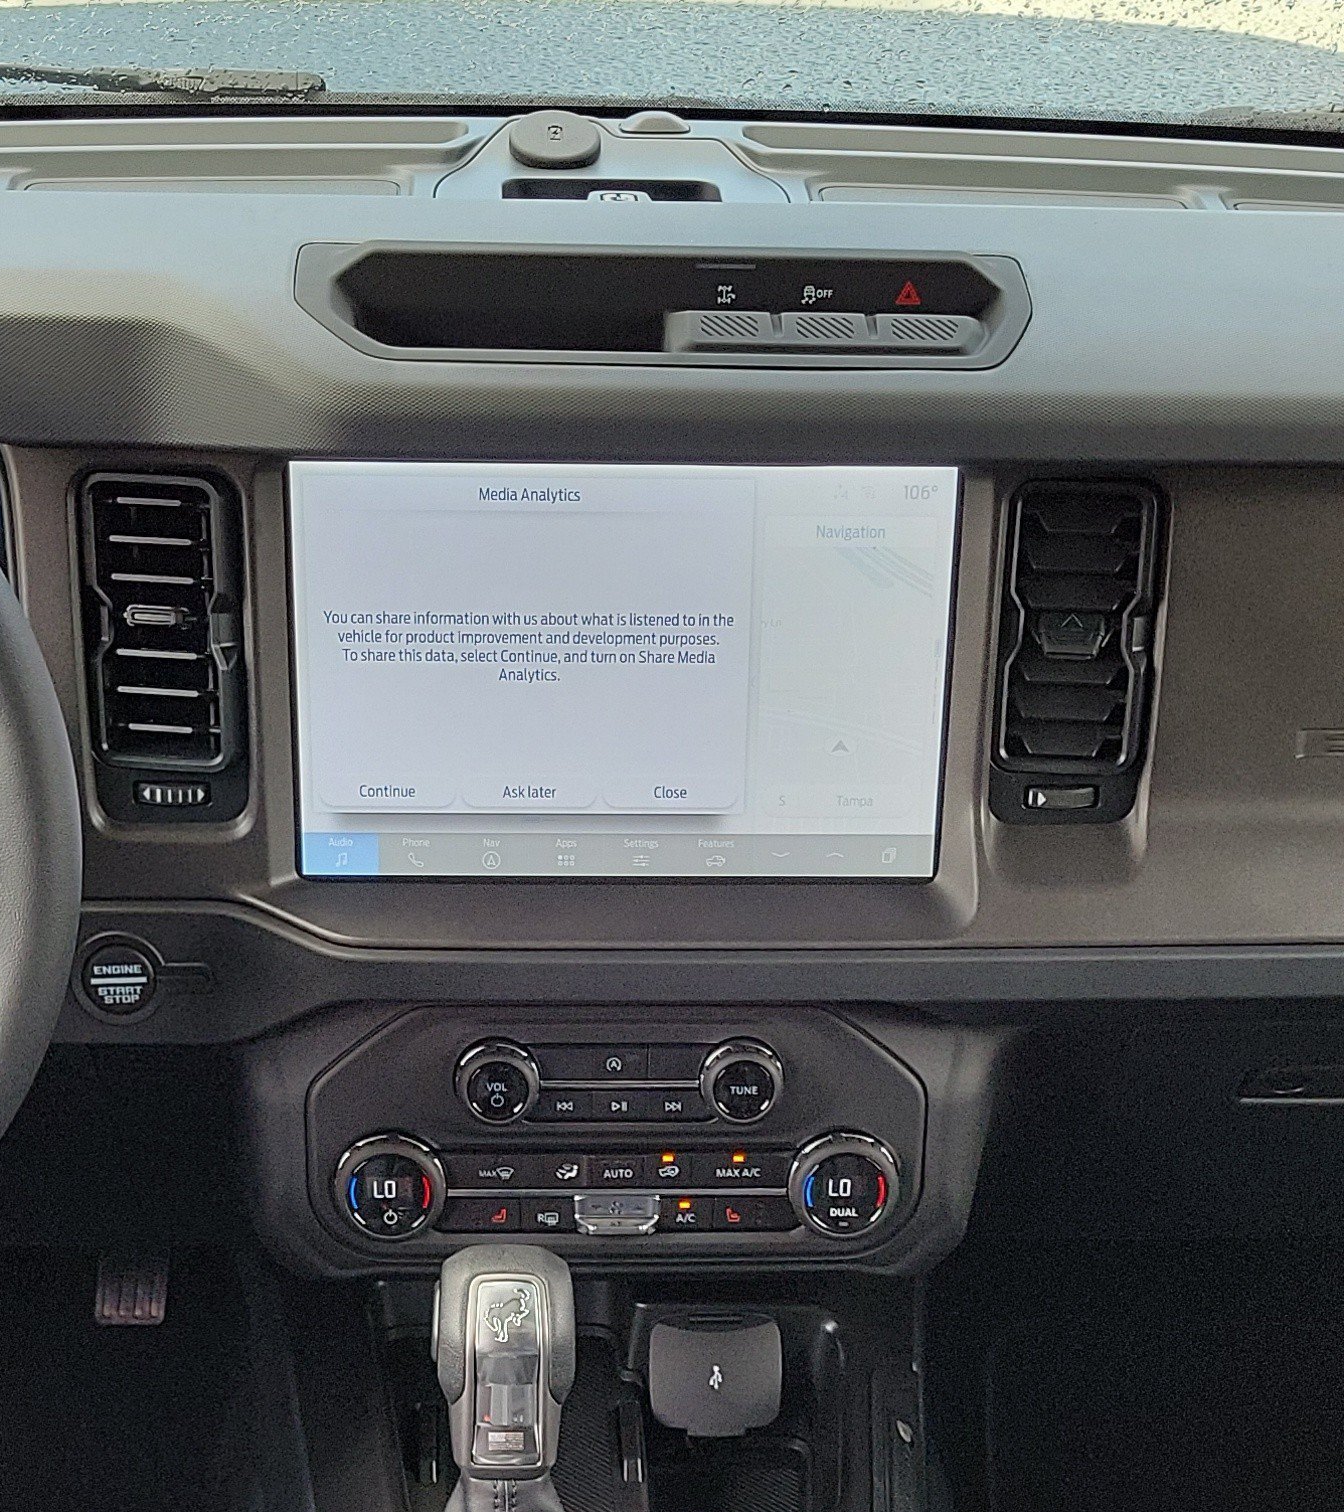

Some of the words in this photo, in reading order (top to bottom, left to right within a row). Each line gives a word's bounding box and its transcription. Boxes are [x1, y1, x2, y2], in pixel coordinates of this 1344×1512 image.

[816, 288, 833, 298] OFF
[479, 487, 517, 501] Media
[521, 487, 581, 504] Analytics
[816, 525, 885, 541] Navigation
[324, 610, 347, 624] You
[351, 612, 373, 624] can
[375, 611, 411, 625] share
[413, 611, 489, 625] information
[492, 612, 521, 625] with
[523, 614, 538, 626] us
[540, 612, 578, 626] about
[581, 613, 614, 626] what
[617, 613, 627, 626] is
[629, 613, 679, 627] listened
[682, 614, 696, 627] to
[698, 613, 710, 627] in
[712, 613, 734, 627] the
[338, 630, 382, 643] vehicle
[385, 630, 403, 643] for
[405, 630, 455, 645] product
[458, 631, 542, 646] improvement
[546, 631, 570, 645] and
[572, 631, 657, 647] development
[659, 633, 720, 647] purposes.
[343, 649, 358, 661] To
[361, 649, 396, 662] share
[399, 649, 422, 662] this
[425, 649, 458, 664] data,
[460, 649, 498, 663] select
[500, 649, 561, 665] Continue,
[564, 650, 587, 663] and
[590, 651, 617, 663] turn
[619, 652, 635, 663] on
[638, 651, 675, 664] Share
[677, 651, 715, 664] Media
[499, 668, 560, 683] Analytics.
[359, 785, 416, 798] Continue
[503, 785, 524, 799] Ask
[527, 785, 556, 799] later
[653, 786, 687, 800] Close
[329, 837, 353, 848] Audio
[402, 838, 431, 848] Phone
[483, 838, 500, 848] Nav
[556, 838, 577, 849] Apps
[624, 838, 659, 849] Settings
[698, 839, 735, 848] Features
[93, 964, 142, 975] ENGINE
[98, 986, 143, 996] START
[104, 995, 140, 1004] STOP
[487, 1083, 507, 1092] VOL
[730, 1085, 758, 1095] TUNE
[604, 1169, 634, 1179] AUTO
[716, 1169, 740, 1178] MAX
[742, 1168, 761, 1178] A/C
[372, 1180, 396, 1199] LO
[828, 1178, 852, 1197] LO
[829, 1208, 858, 1217] DUAL
[675, 1214, 696, 1223] A/C
